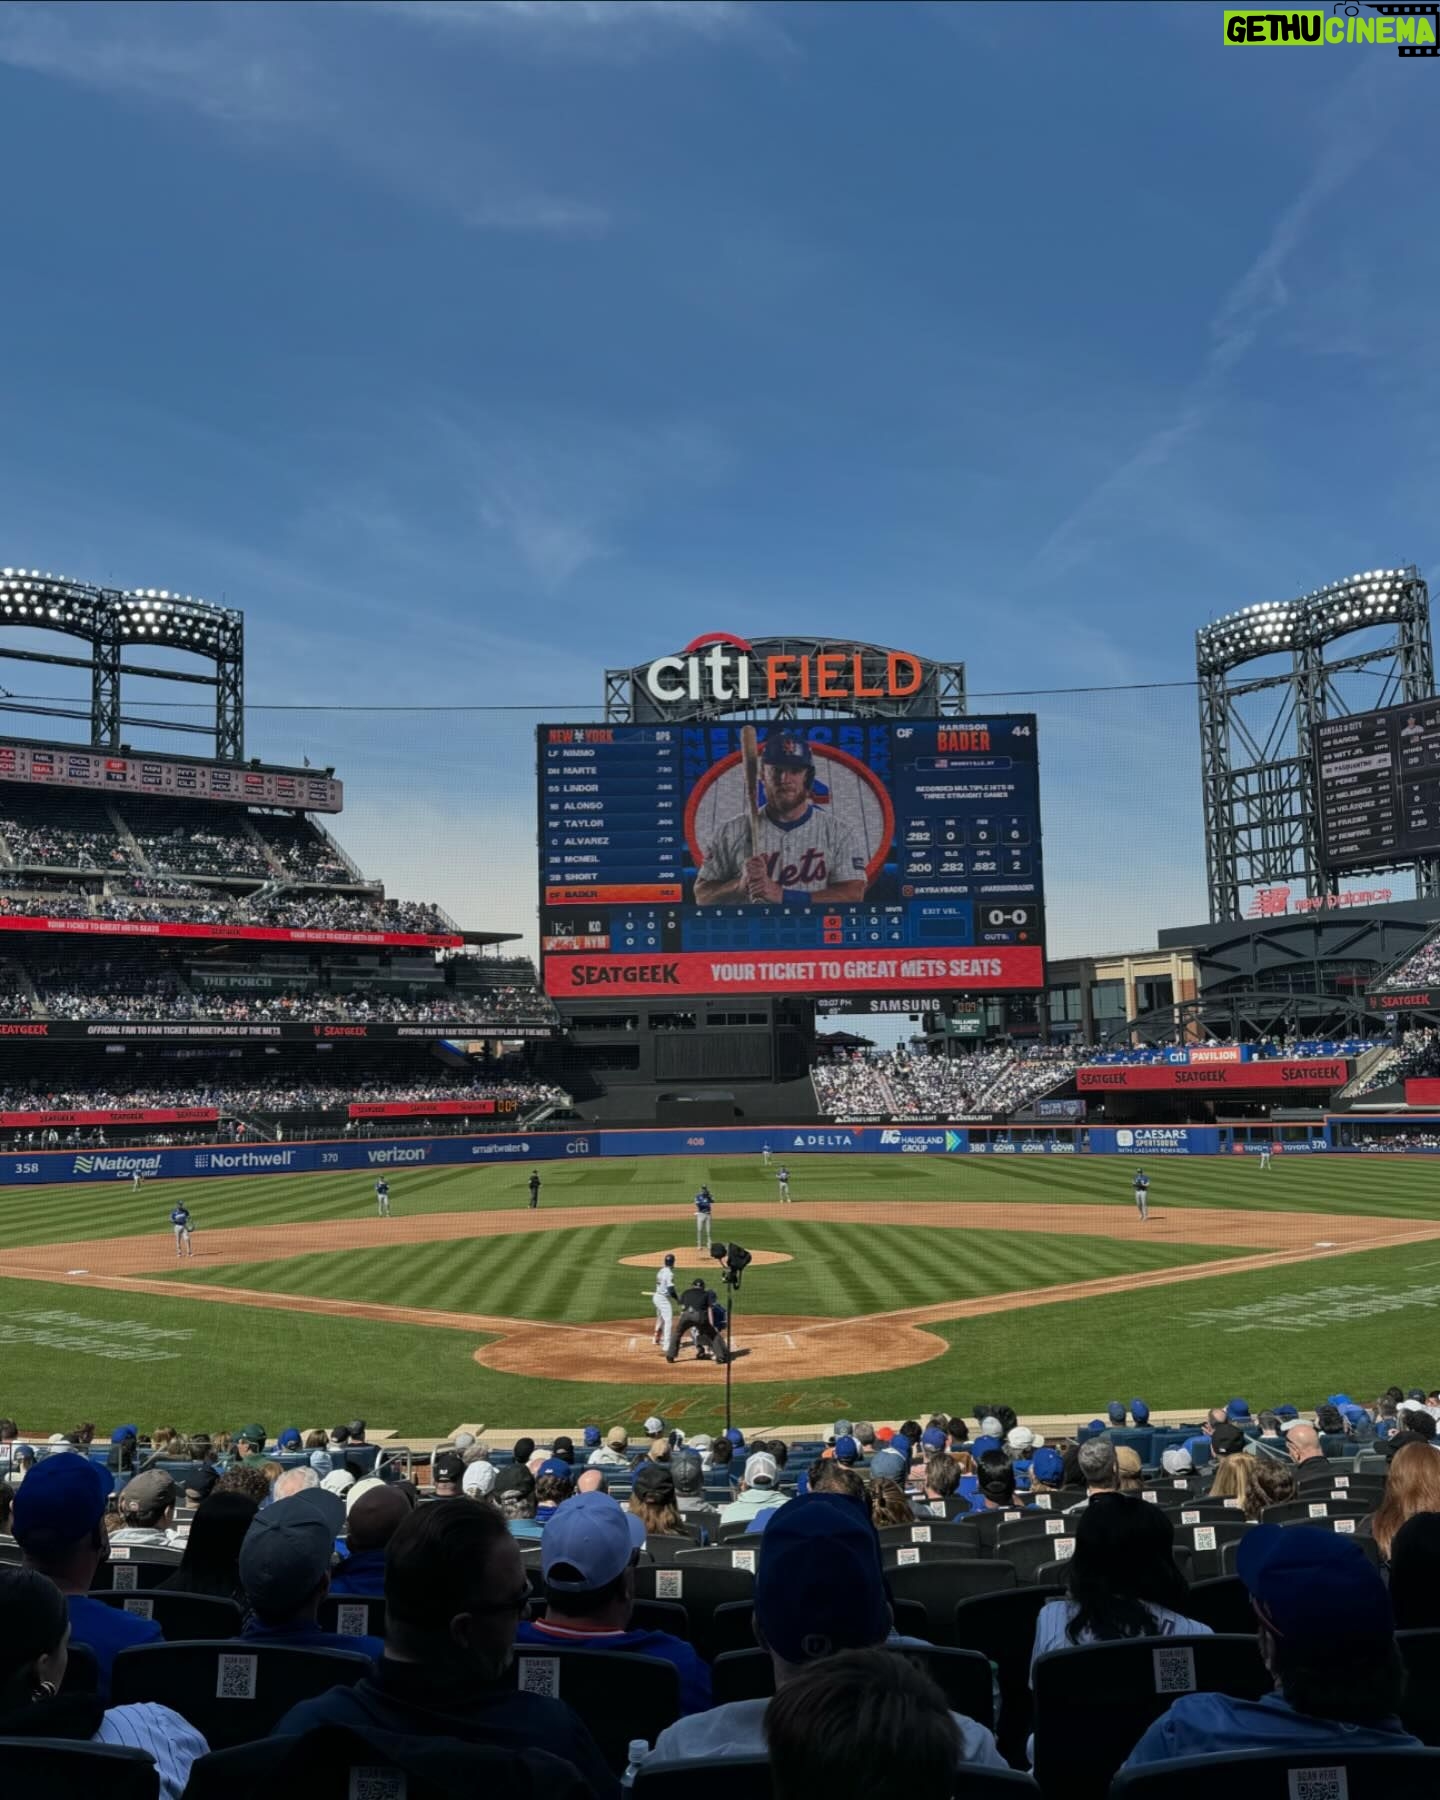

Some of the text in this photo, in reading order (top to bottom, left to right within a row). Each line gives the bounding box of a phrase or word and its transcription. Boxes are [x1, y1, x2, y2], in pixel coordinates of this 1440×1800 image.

[647, 643, 922, 701] citi FIELD
[548, 729, 613, 744] NEW YORK
[1012, 726, 1030, 737] 44
[936, 731, 991, 752] BADER
[563, 749, 595, 757] NIMMO
[563, 767, 597, 775] MARTE
[563, 784, 598, 792] LINDOR
[564, 802, 604, 810] ALONSO
[564, 819, 604, 828] TAYLOR
[946, 831, 955, 841] 0
[979, 831, 987, 840] 0
[564, 837, 610, 846] ALVAREZ
[564, 855, 600, 863] MCNEIL
[940, 862, 964, 871] .282
[1013, 861, 1021, 870] 2
[564, 872, 598, 881] SHORT
[1327, 889, 1392, 910] balance
[988, 909, 1028, 925] 0-0
[625, 922, 634, 930] 0
[647, 922, 655, 930] 0
[667, 921, 676, 929] 0
[870, 917, 878, 925] 0
[626, 937, 634, 945] 0
[648, 937, 656, 945] 0
[852, 933, 857, 941] 1
[871, 932, 879, 940] 0
[891, 932, 899, 940] 4
[571, 963, 680, 986] SEATGEEK
[711, 958, 1002, 981] YOUR TICKET TO GREAT METS SEATS
[203, 976, 272, 987] THE PORCH
[870, 999, 940, 1012] SAMSUNG
[1381, 993, 1431, 1008] SEATGEEK
[148, 1026, 161, 1034] FAN
[163, 1026, 187, 1035] TICKET
[324, 1026, 368, 1037] SEATGEEK
[1169, 1051, 1187, 1063] citi
[1191, 1050, 1237, 1061] PAVILION
[1081, 1072, 1127, 1085] SEATGEEK
[1175, 1069, 1226, 1084] SEATGEEK
[1282, 1065, 1340, 1081] SEATGEEK
[808, 1134, 852, 1146] DELTA
[1134, 1129, 1188, 1140] CAESARS
[566, 1140, 589, 1153] citi
[901, 1137, 944, 1145] HAUGLAND
[1135, 1139, 1179, 1147] SPORTSBOOK
[1312, 1140, 1327, 1149] 370
[472, 1143, 522, 1154] smartwater
[901, 1144, 928, 1152] GROUP
[969, 1143, 985, 1152] 380
[211, 1150, 293, 1168] Northwell
[321, 1153, 338, 1163] 370
[368, 1147, 425, 1163] verizon
[15, 1163, 39, 1174] 358
[94, 1154, 161, 1172] National
